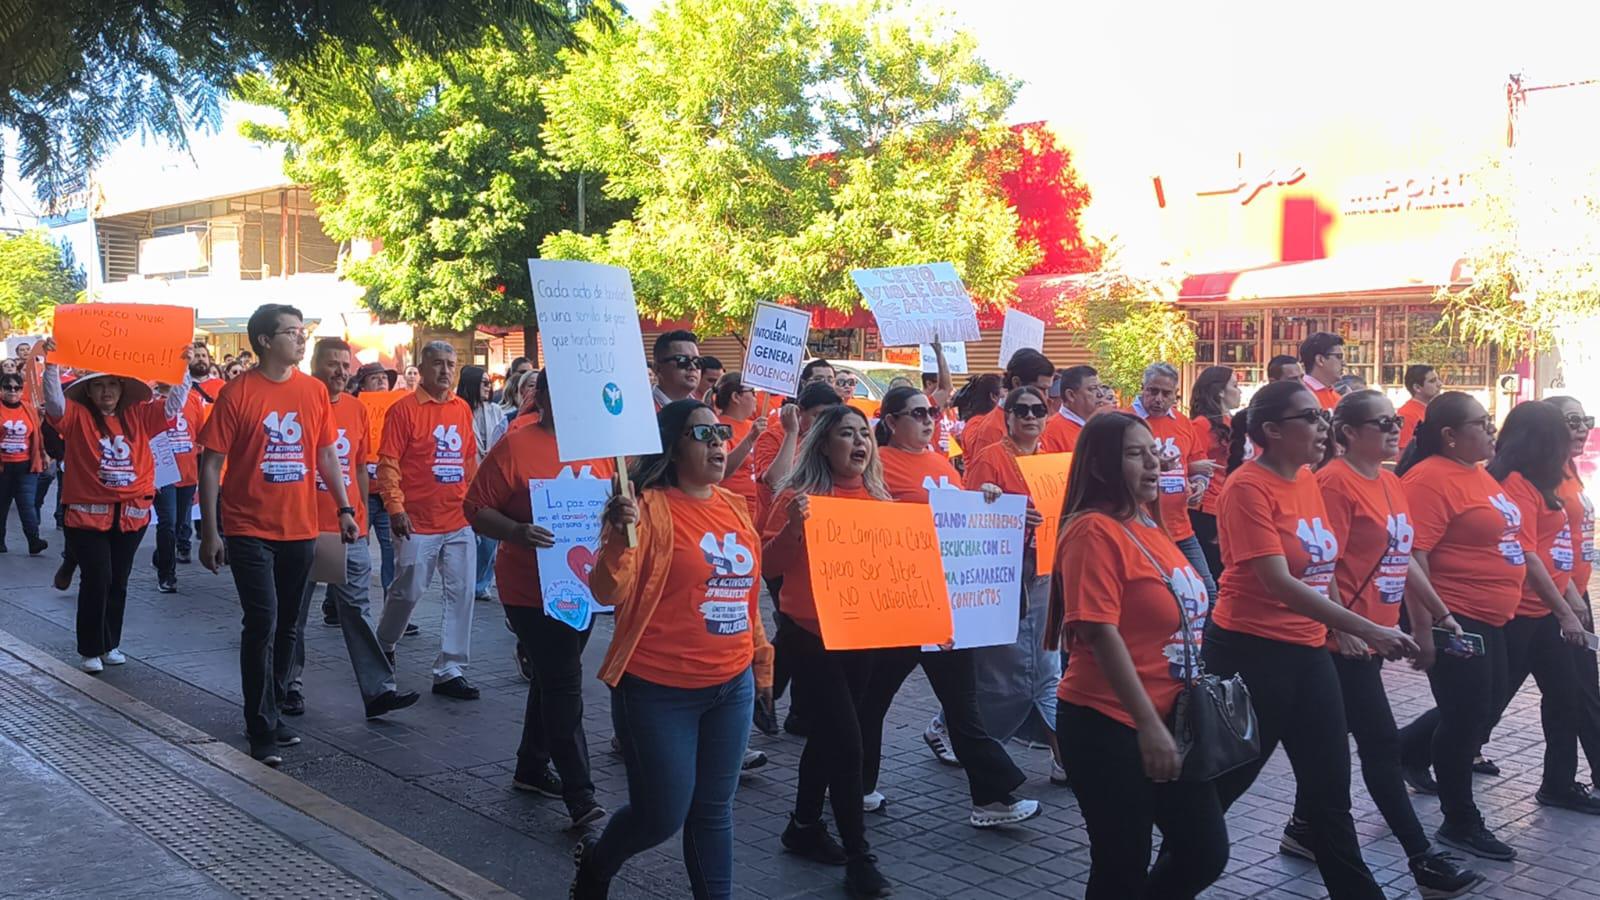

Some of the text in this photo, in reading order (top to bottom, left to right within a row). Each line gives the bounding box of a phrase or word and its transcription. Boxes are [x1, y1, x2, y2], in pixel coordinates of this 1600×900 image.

[873, 266, 936, 284] CERO
[537, 279, 569, 299] Cada
[863, 281, 968, 301] VIOLENCIA
[136, 313, 164, 324] VIVIR
[551, 311, 572, 323] una
[775, 317, 787, 332] LA
[99, 320, 128, 338] SIN
[754, 326, 803, 347] INTOLERANCIA
[881, 319, 979, 345] CONVIVIR
[551, 335, 569, 352] que
[754, 345, 794, 366] GENERA
[747, 362, 796, 385] VIOLENCIA
[2, 419, 28, 435] 16
[262, 411, 303, 444] 16
[98, 435, 130, 460] 16
[432, 424, 462, 452] 16
[546, 489, 562, 509] La
[1000, 539, 1012, 555] EL
[1296, 517, 1339, 564] 16
[699, 531, 753, 576] 16
[960, 566, 1015, 586] DESAPARECEN
